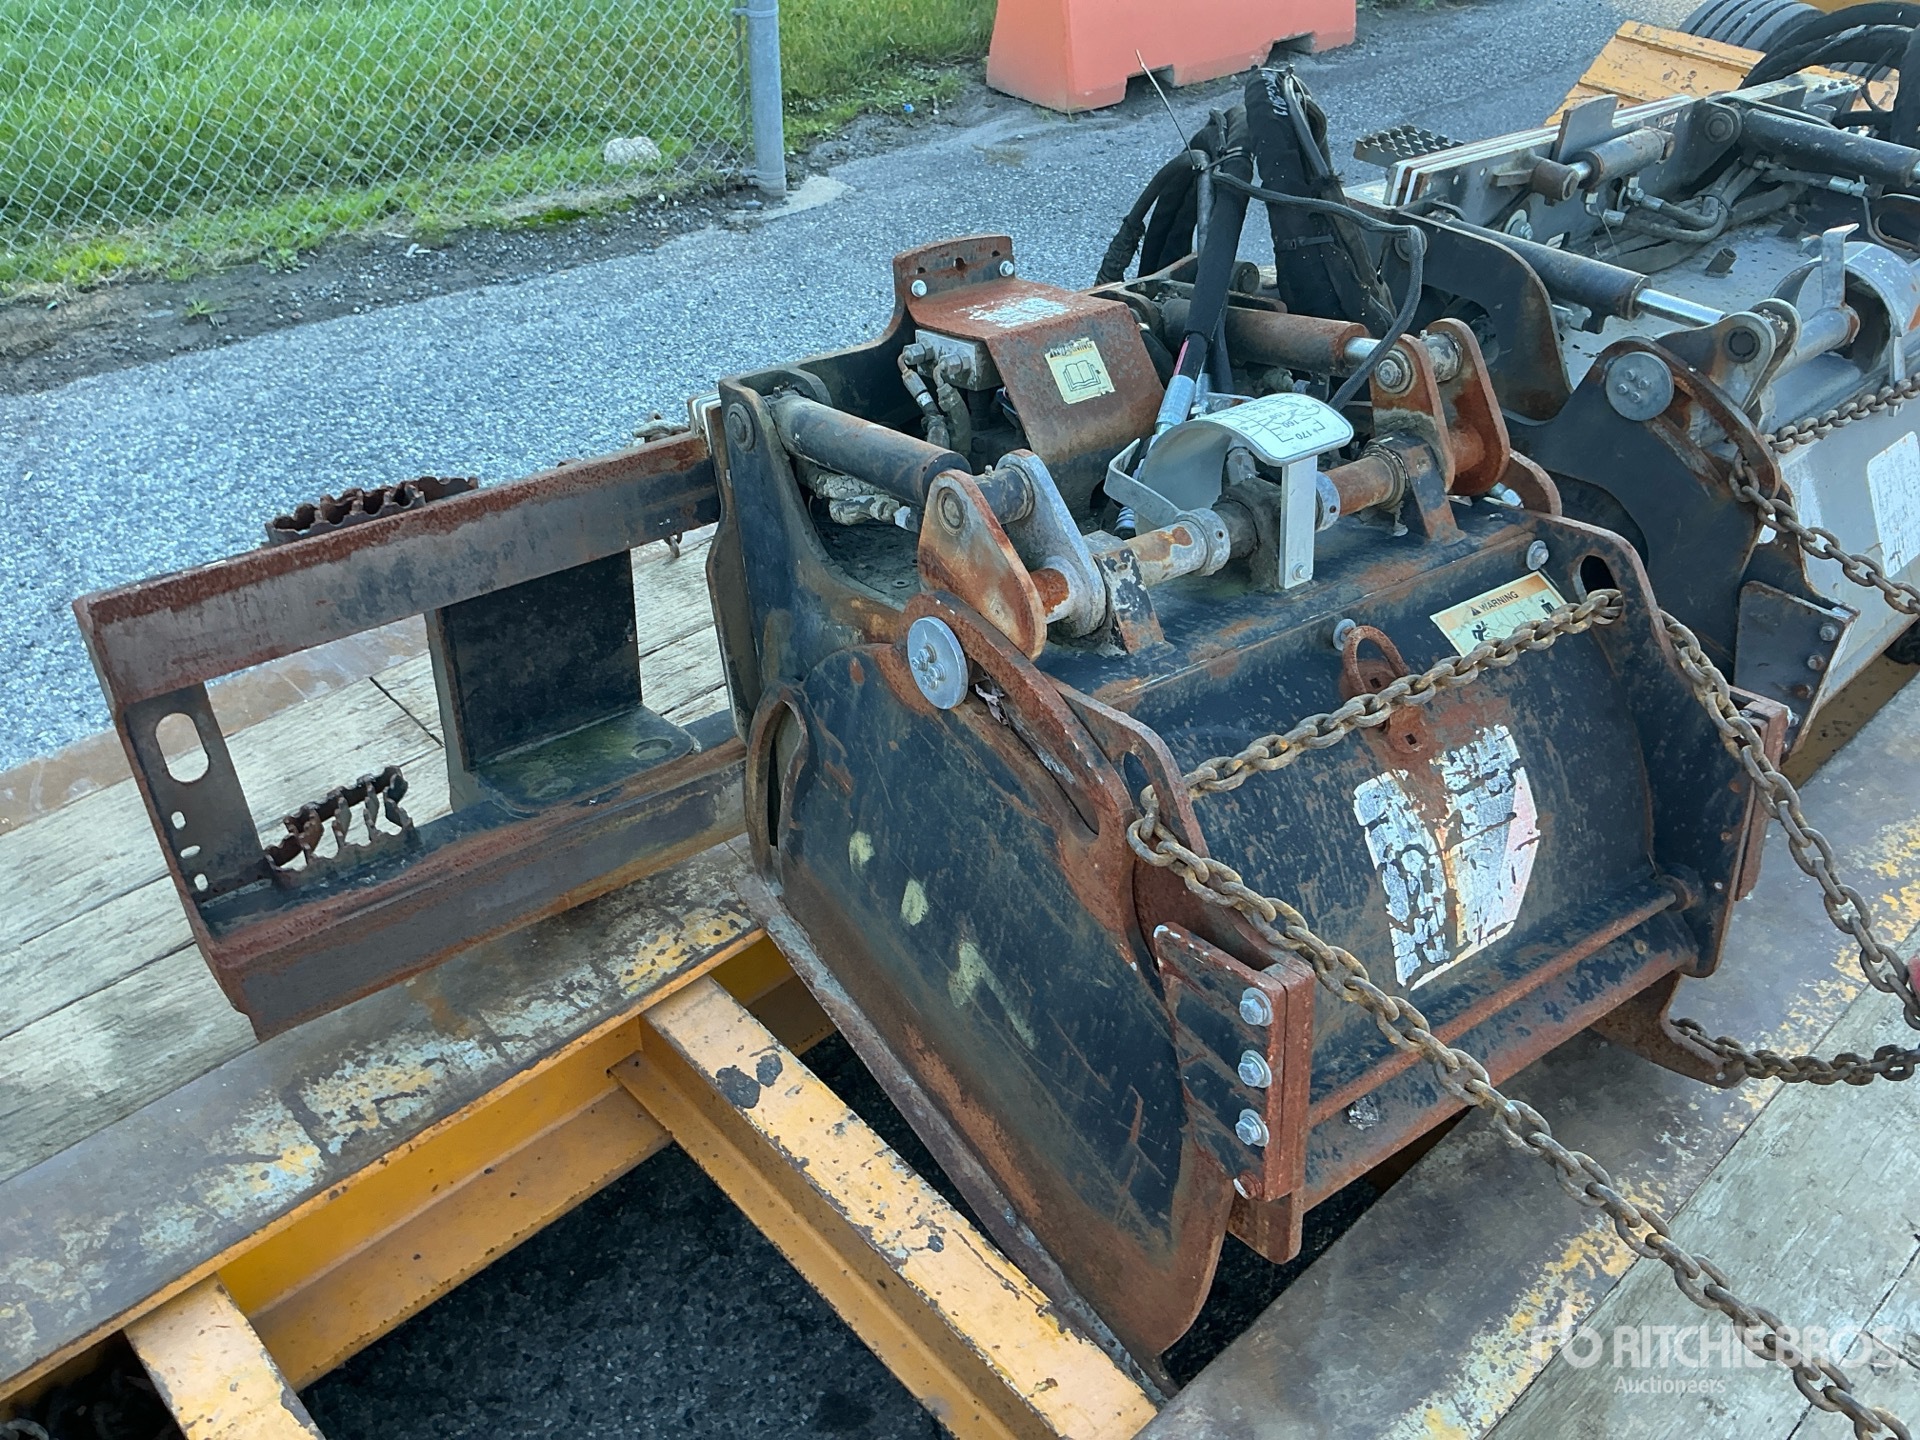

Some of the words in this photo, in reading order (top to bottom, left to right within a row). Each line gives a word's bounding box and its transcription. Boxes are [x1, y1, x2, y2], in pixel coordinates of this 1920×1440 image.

[1282, 419, 1299, 428] 160
[1295, 430, 1312, 440] 170
[1478, 590, 1520, 612] WARNING
